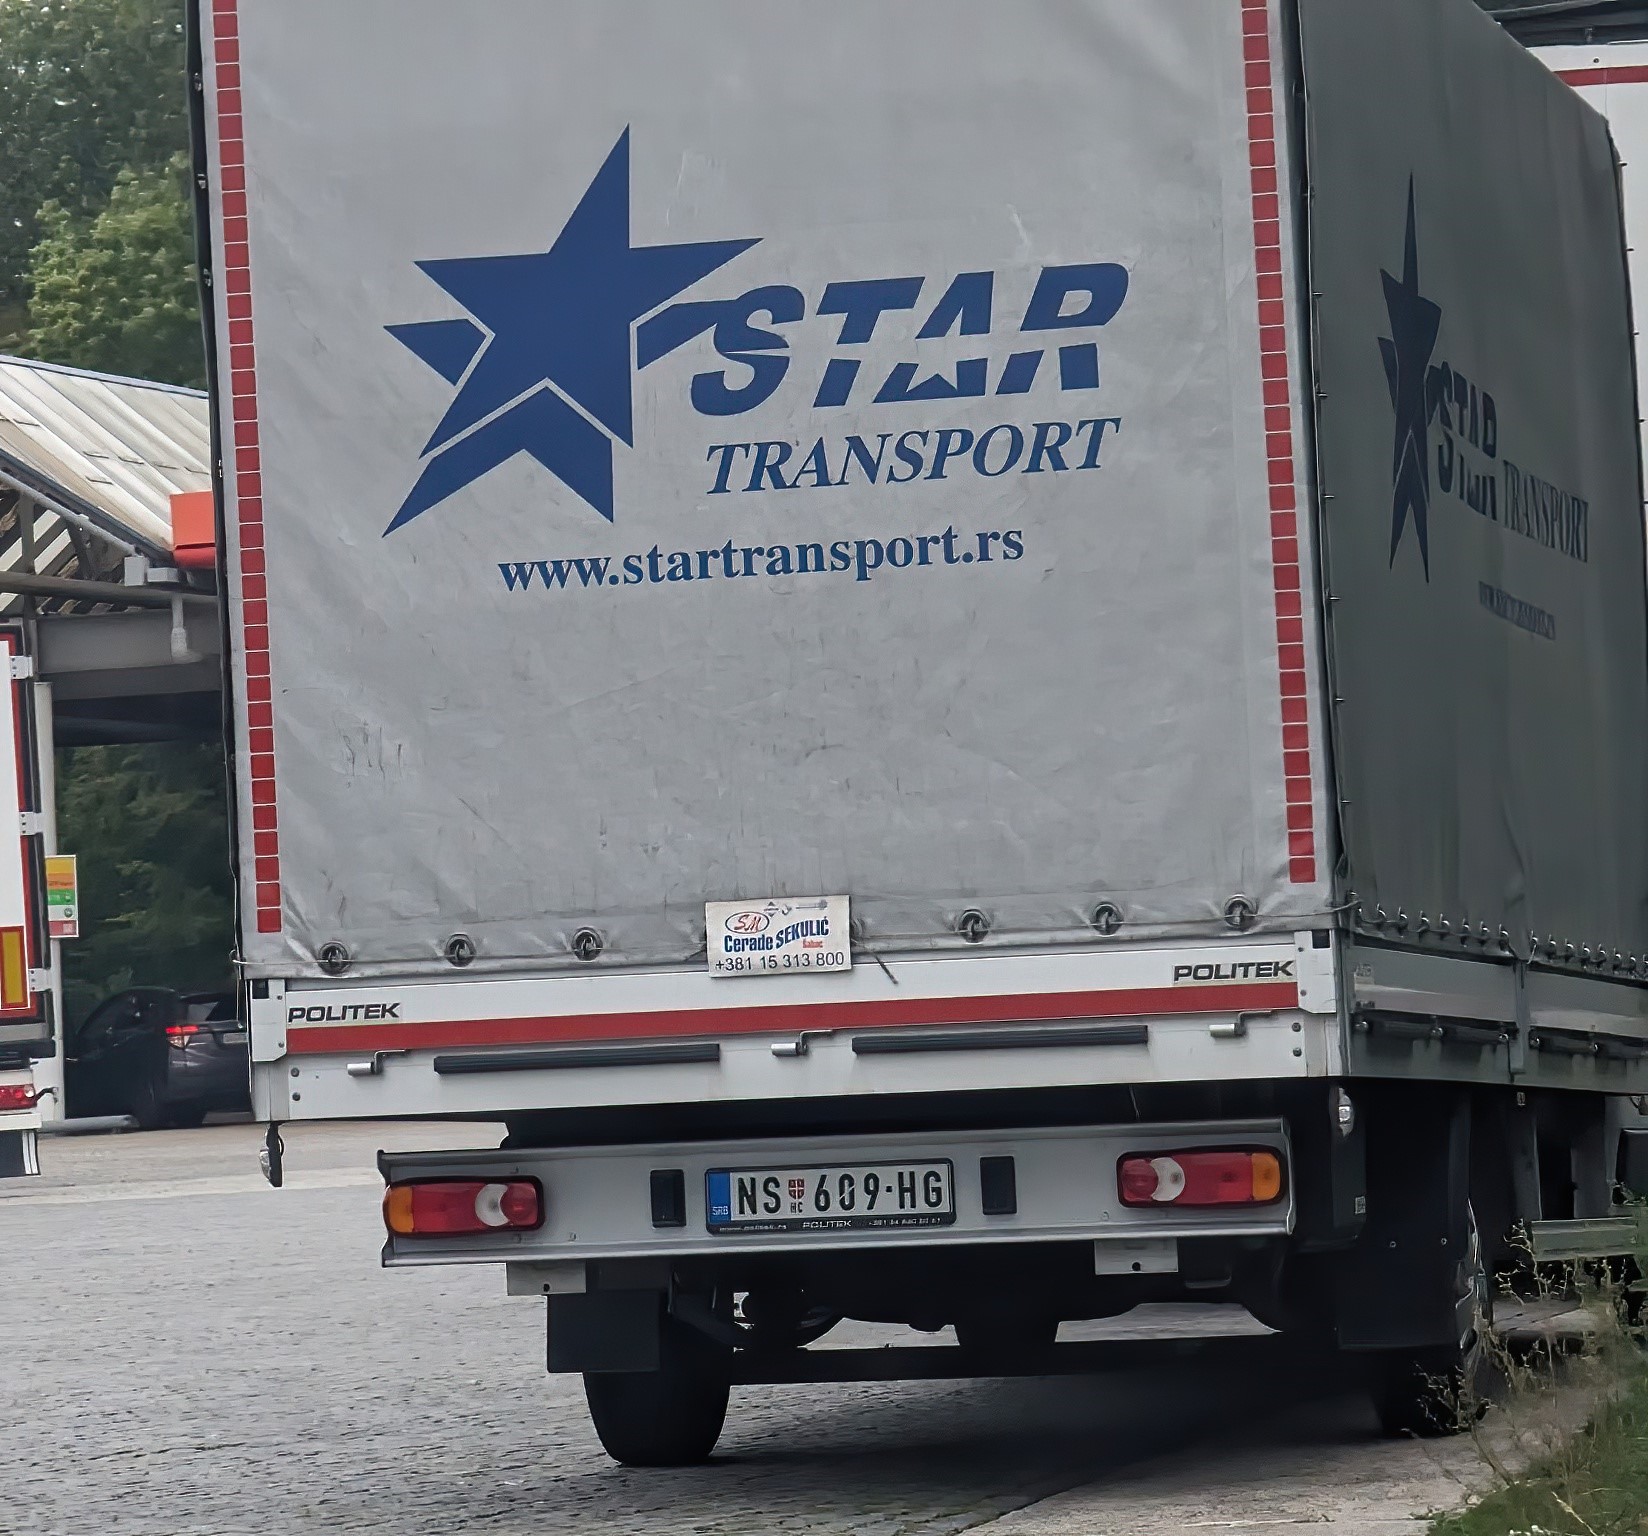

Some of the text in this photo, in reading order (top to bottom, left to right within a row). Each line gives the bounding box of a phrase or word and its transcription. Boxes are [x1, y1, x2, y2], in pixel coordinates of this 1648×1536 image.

[690, 262, 1129, 416] STAR
[706, 417, 1122, 495] TRANSPORT
[497, 525, 1025, 592] www.startransport.rs
[724, 915, 830, 953] Cerade SEKULIĆ
[715, 951, 844, 971] +381 15 313 800
[1174, 960, 1294, 982] POLITEK
[288, 1002, 400, 1023] POLITEK
[737, 1176, 781, 1216] NS
